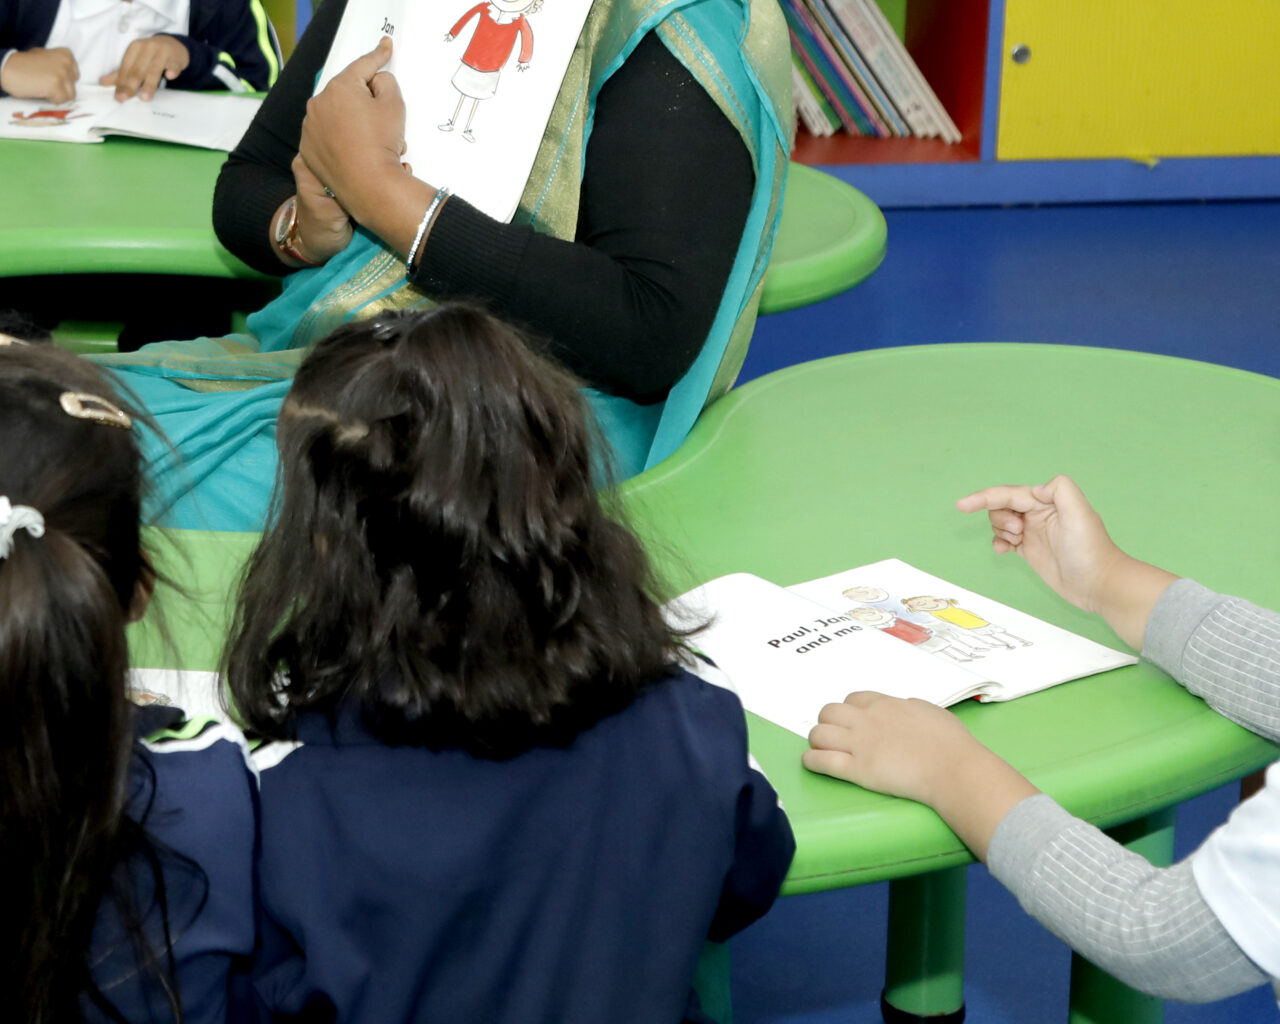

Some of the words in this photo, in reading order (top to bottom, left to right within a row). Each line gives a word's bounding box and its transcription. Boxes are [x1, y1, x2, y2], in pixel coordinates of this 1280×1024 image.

[381, 17, 394, 36] Jan
[767, 626, 819, 648] Paul,
[795, 634, 832, 654] and
[833, 625, 863, 637] me
